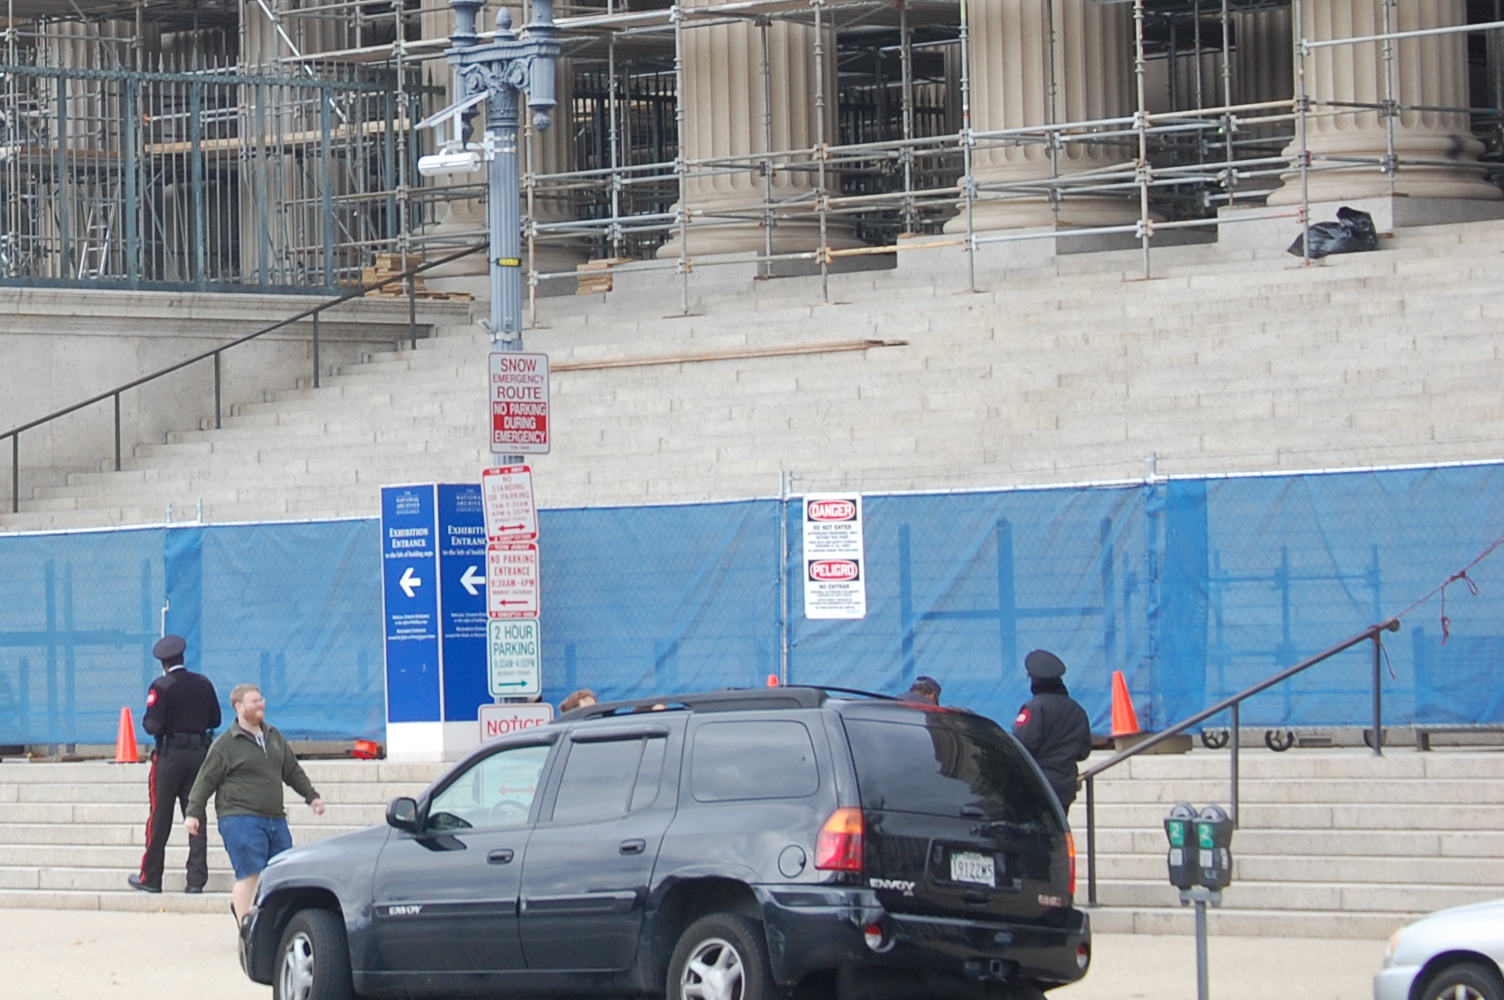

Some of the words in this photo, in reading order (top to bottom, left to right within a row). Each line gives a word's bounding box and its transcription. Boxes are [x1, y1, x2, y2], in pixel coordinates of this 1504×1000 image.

[501, 358, 536, 372] SNOW
[493, 374, 545, 383] EMERGENCY
[497, 386, 541, 399] ROUTE
[494, 402, 507, 415] NO
[510, 403, 546, 416] PARKING
[504, 416, 536, 429] DURING
[495, 430, 545, 443] EMERGENCY
[492, 483, 524, 493] STANDING
[501, 491, 530, 500] PARKING
[811, 504, 852, 517] DANGER
[389, 528, 428, 537] EXHIBITION
[448, 525, 486, 534] EXHIBITI
[392, 538, 427, 548] ENTRANCE
[451, 536, 487, 545] ENTRANC
[491, 555, 500, 564] NO
[503, 555, 534, 563] PARKING
[494, 567, 530, 576] ENTRANCE
[813, 564, 854, 577] PELIGRO
[495, 625, 501, 639] 2
[505, 625, 533, 639] HOUR
[494, 642, 535, 656] PARKING
[1172, 823, 1180, 838] 2
[1202, 825, 1210, 839] 2
[870, 878, 915, 890] ENVOY
